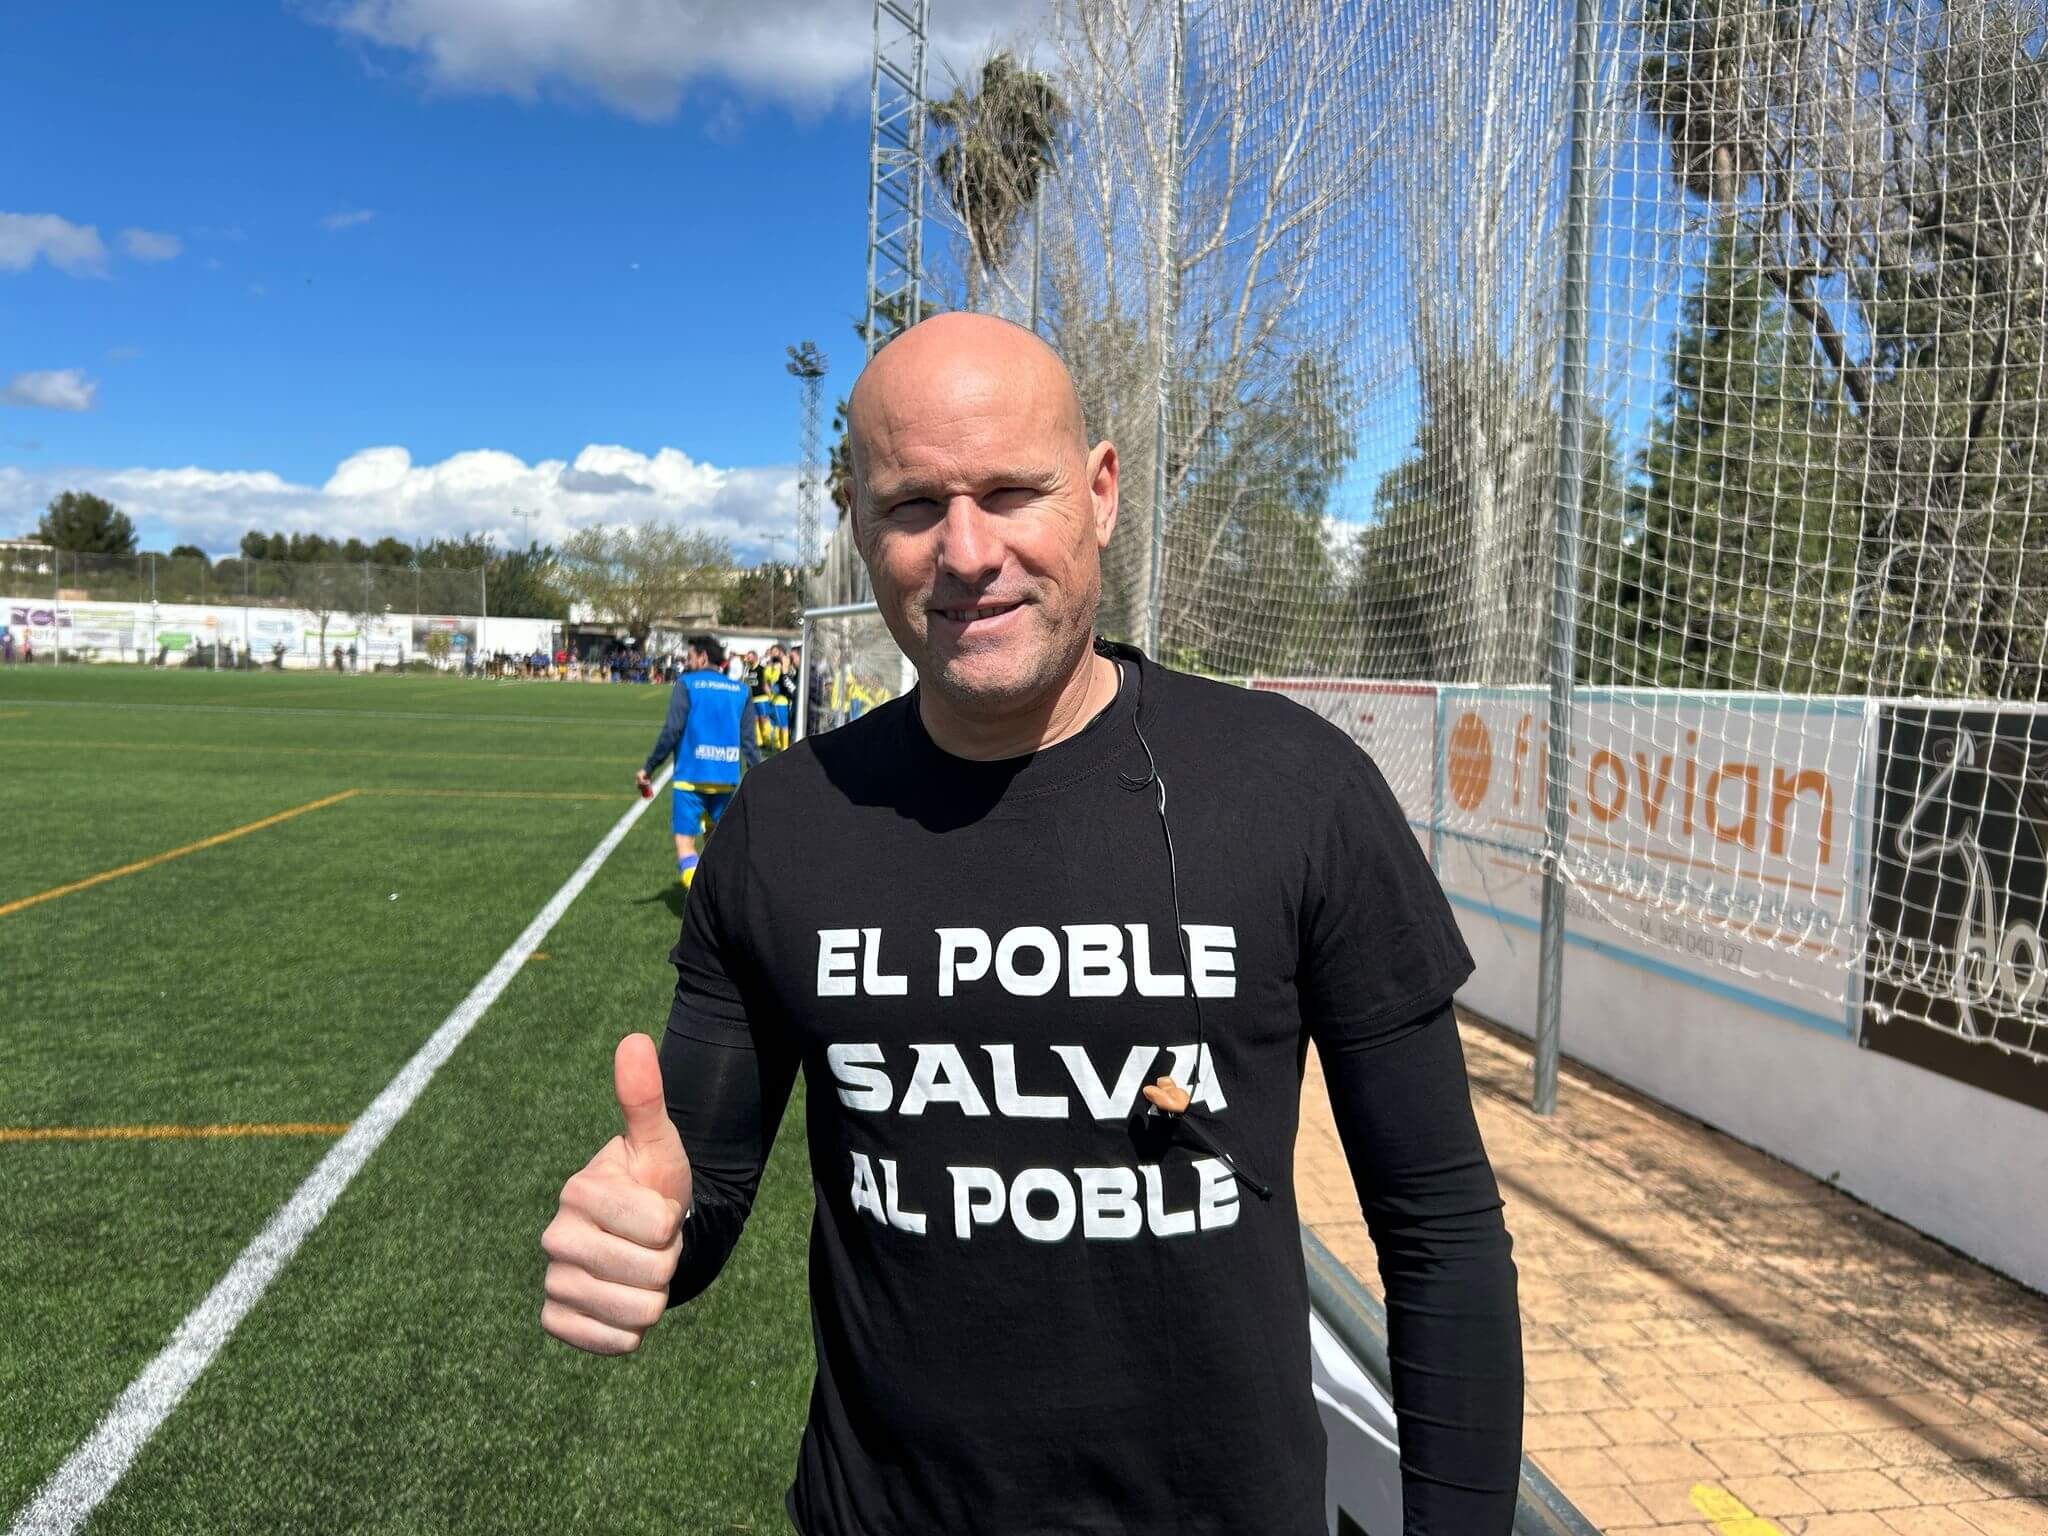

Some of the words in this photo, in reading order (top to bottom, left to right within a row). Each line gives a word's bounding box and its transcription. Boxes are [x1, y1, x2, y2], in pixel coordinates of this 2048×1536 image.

[1512, 712, 1835, 865] fiovian
[816, 927, 908, 997] EL
[934, 923, 1238, 998] POBLE
[827, 1042, 1228, 1120] SALVA
[849, 1150, 927, 1237] AL
[946, 1154, 1241, 1242] POBLE
